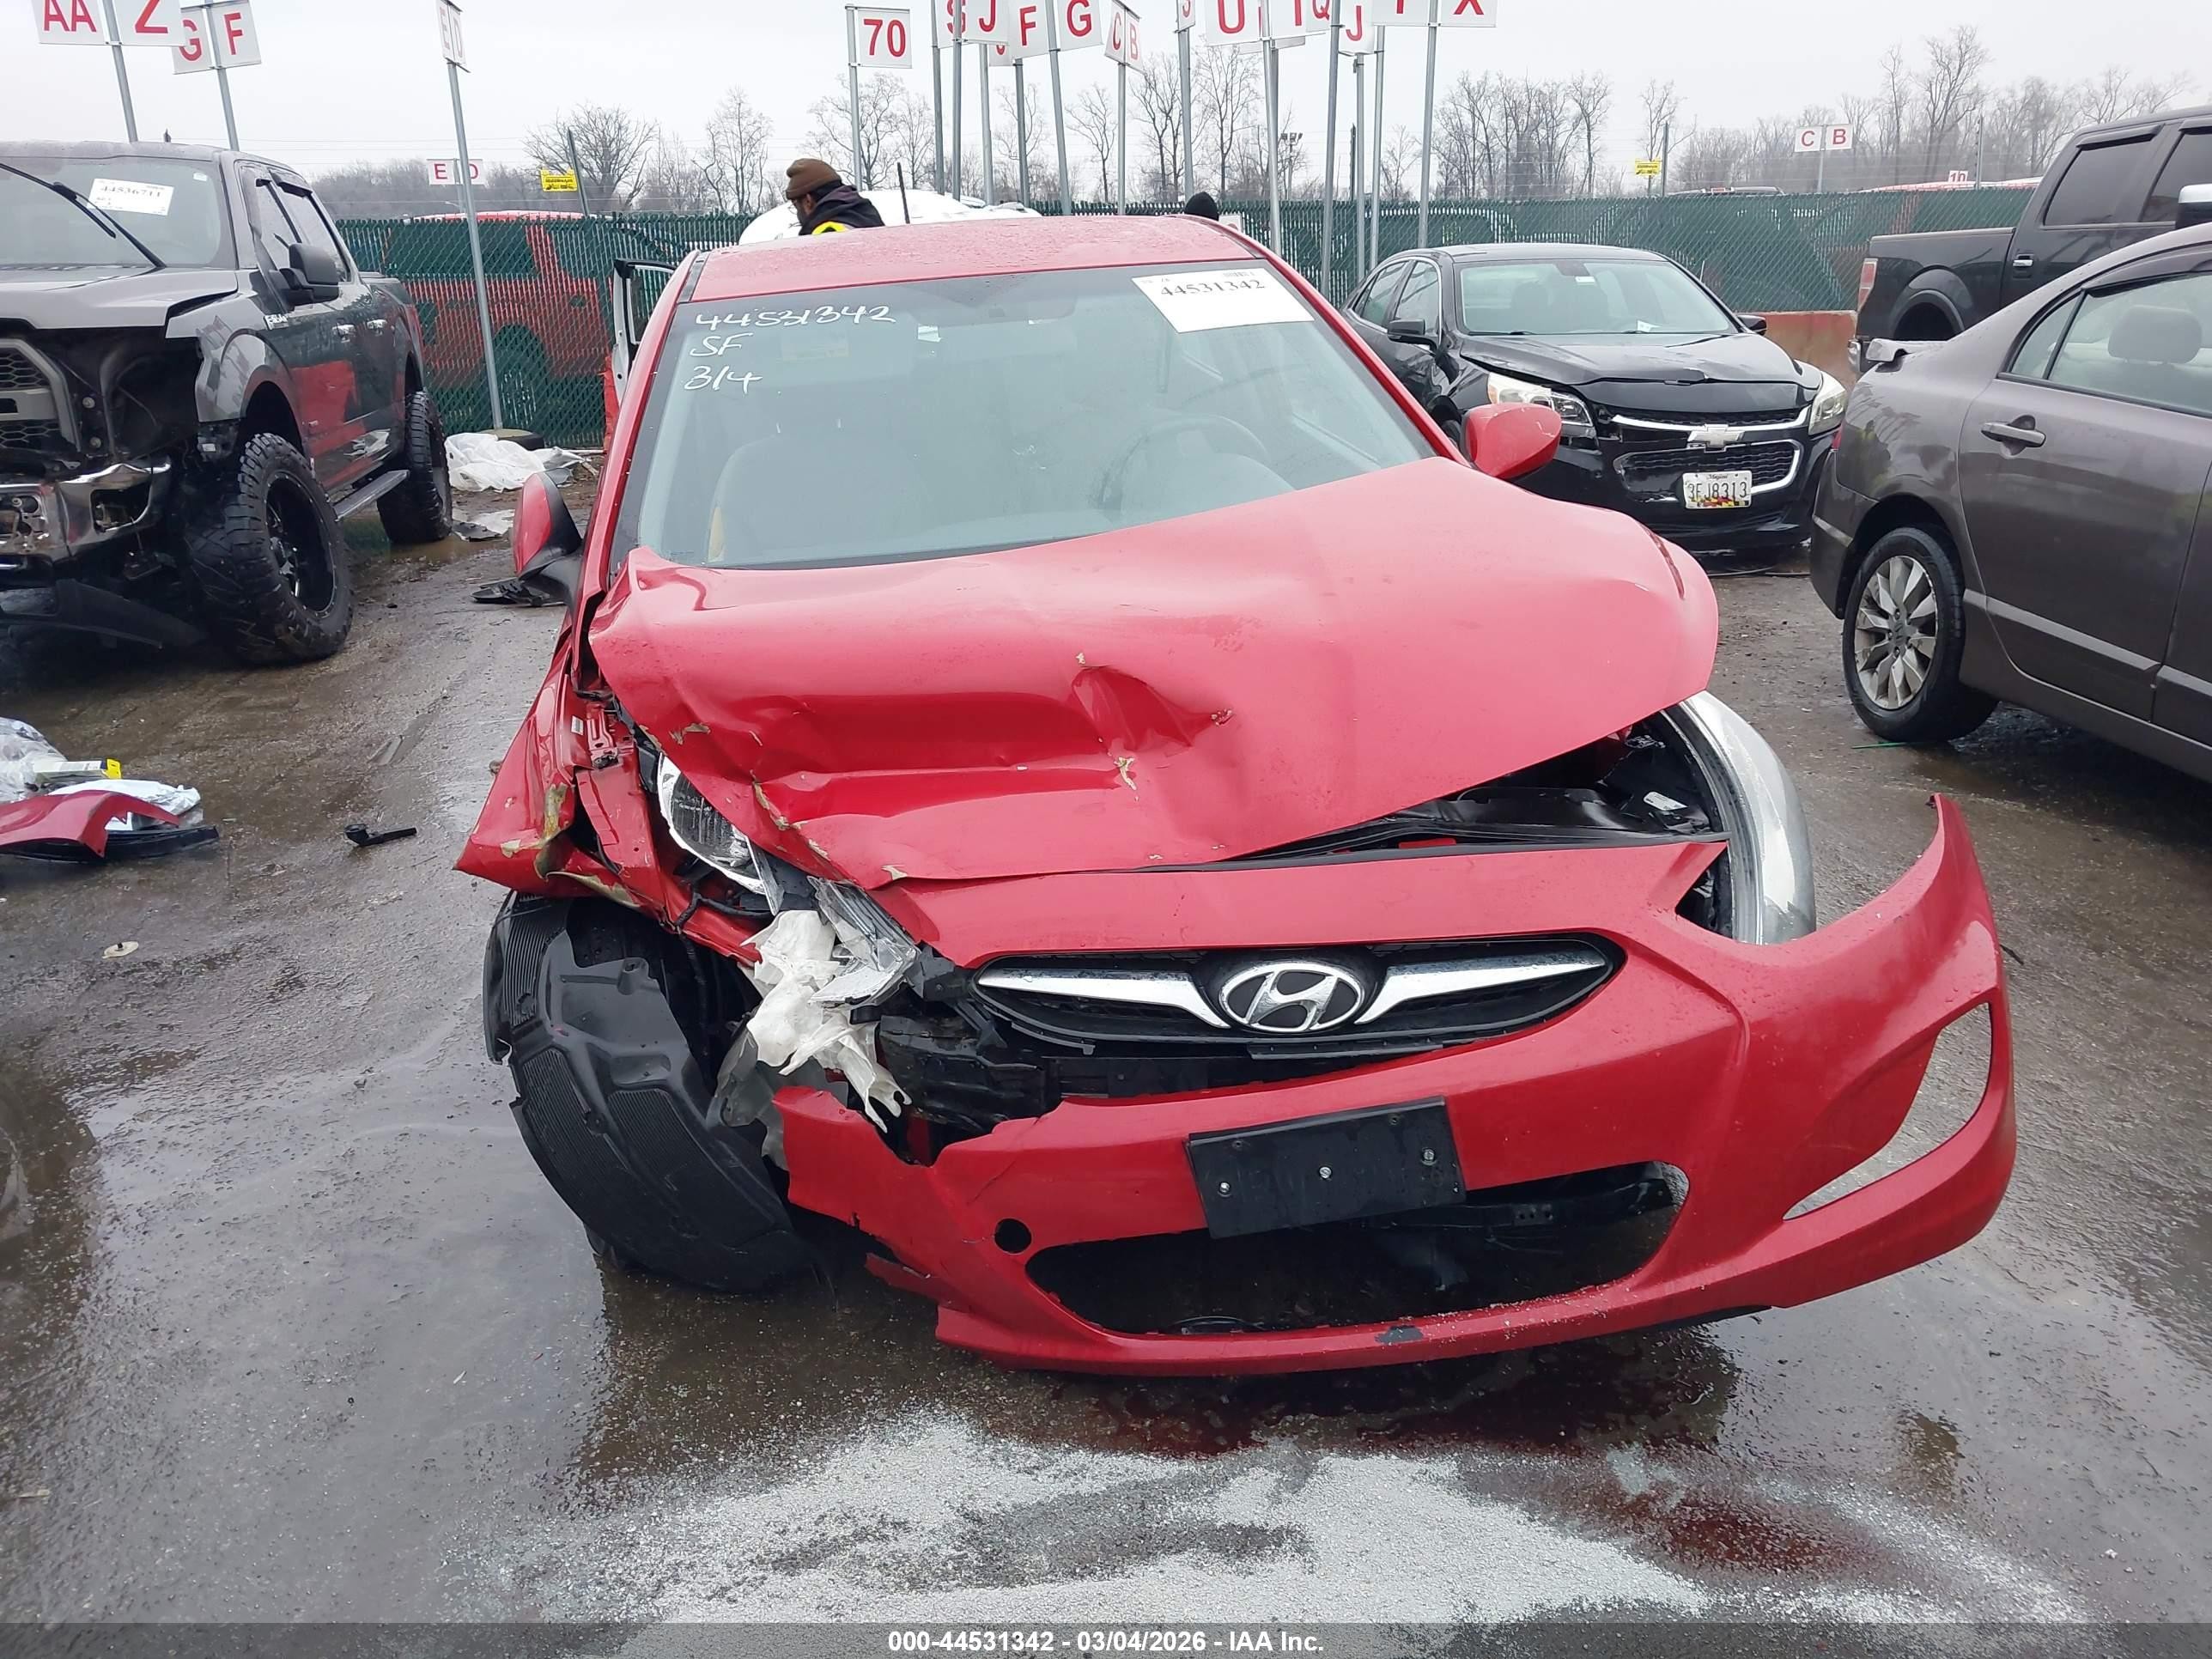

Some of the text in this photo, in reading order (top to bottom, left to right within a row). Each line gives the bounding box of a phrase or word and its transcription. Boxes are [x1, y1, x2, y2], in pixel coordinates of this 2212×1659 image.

[43, 0, 168, 34] AA Z
[1019, 0, 1092, 46] F G
[1345, 5, 1363, 41] J
[179, 12, 244, 62] G F
[863, 18, 907, 58] 70
[1112, 12, 1139, 60] C B
[1801, 128, 1846, 147] C B
[434, 163, 448, 179] E
[1161, 279, 1266, 296] 44531342
[690, 332, 754, 357] SF
[684, 365, 763, 394] 3/4
